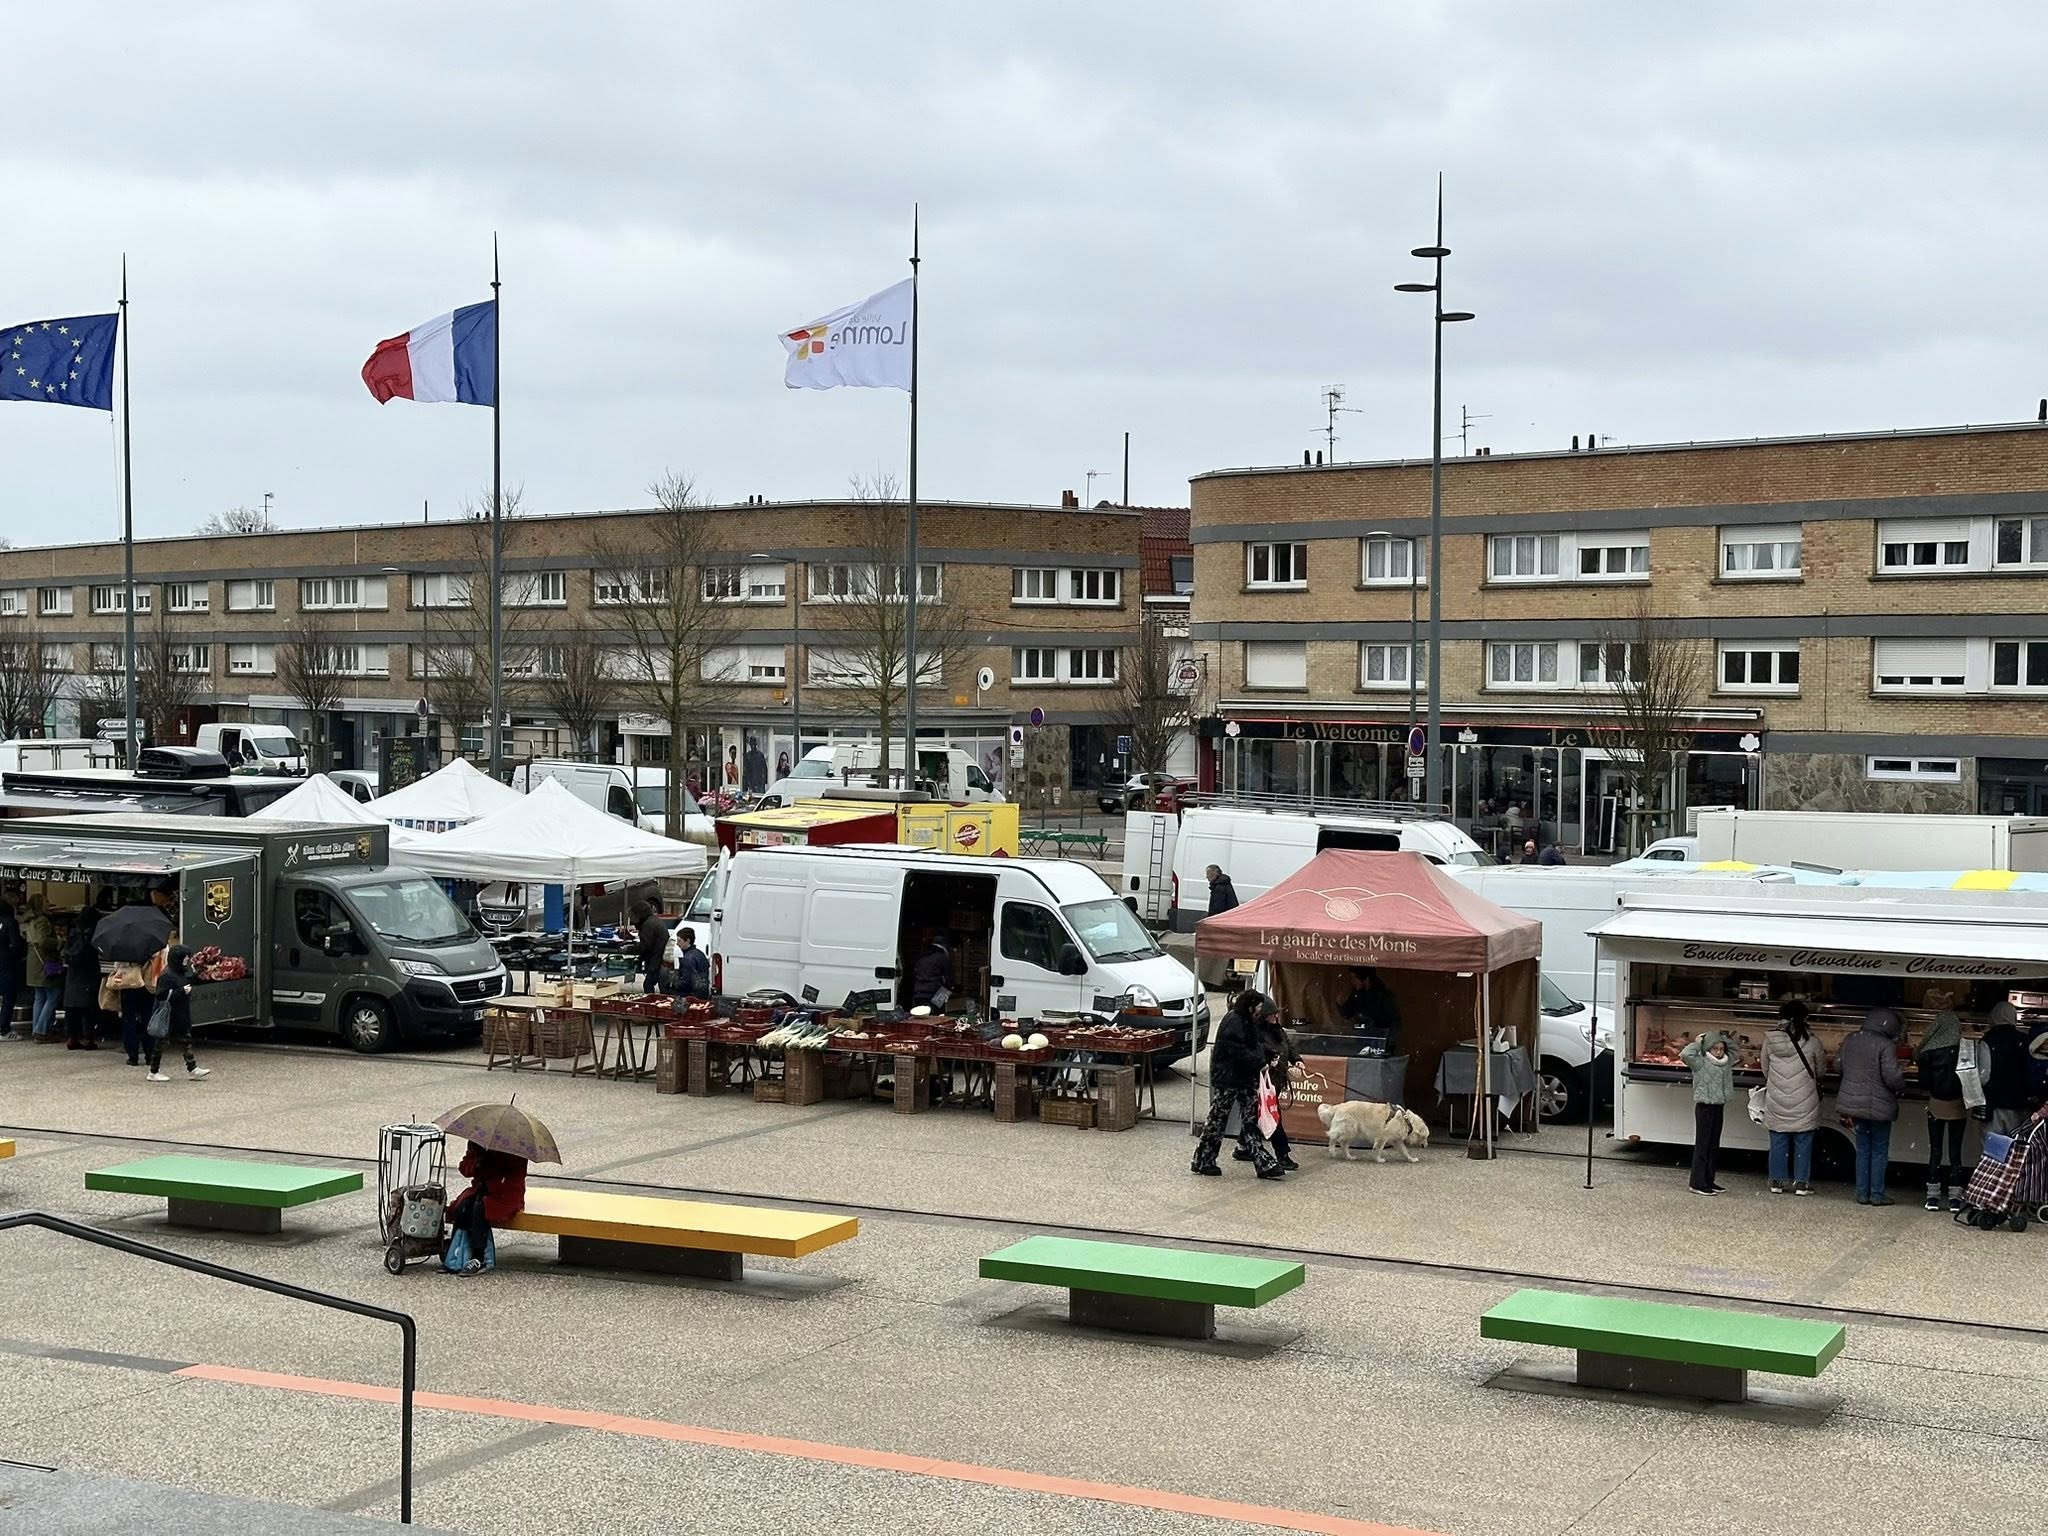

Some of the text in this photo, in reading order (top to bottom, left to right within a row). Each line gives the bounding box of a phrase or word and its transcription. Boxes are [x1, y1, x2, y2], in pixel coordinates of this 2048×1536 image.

[1283, 722, 1400, 741] Le Welcome
[1551, 728, 1691, 749] Le Welcme
[19, 867, 47, 880] Caves
[51, 870, 65, 882] De
[67, 871, 92, 884] Max
[1260, 930, 1417, 953] La gaufre des Monts
[1296, 949, 1323, 961] locale
[1683, 943, 1768, 962] Boucherie
[1789, 949, 1882, 969] Chevaline
[1905, 956, 2018, 976] Charcuterie
